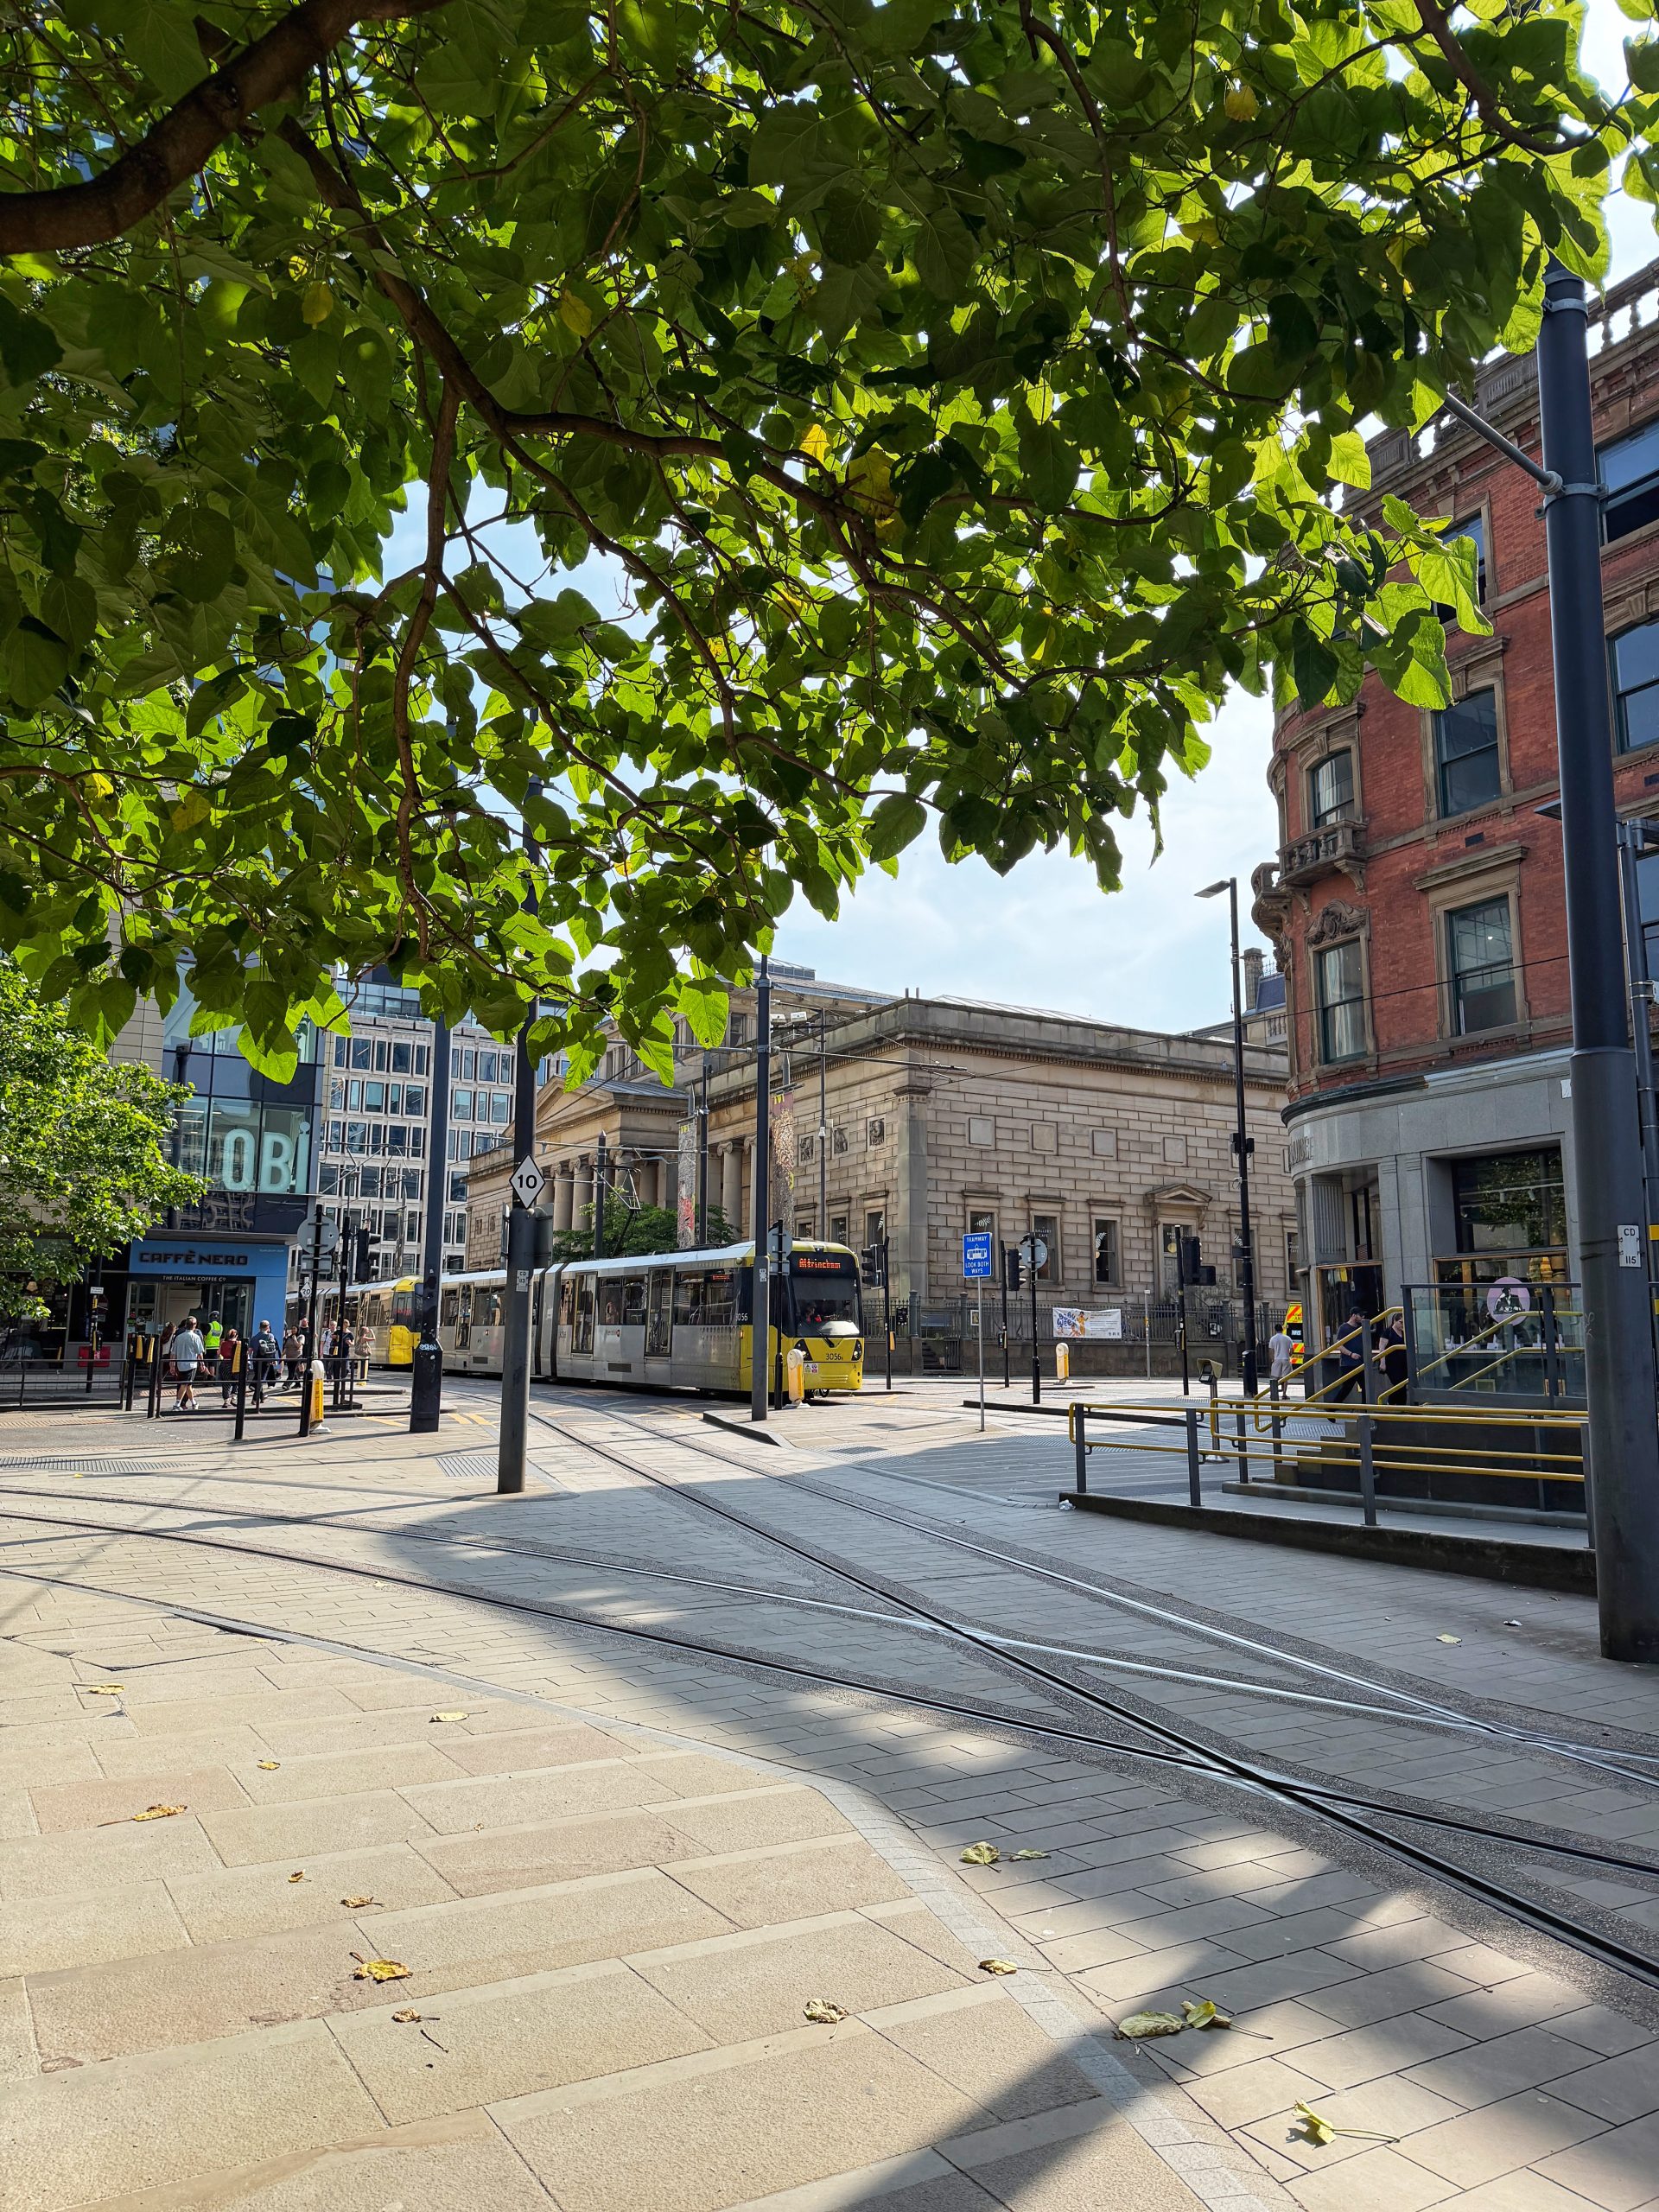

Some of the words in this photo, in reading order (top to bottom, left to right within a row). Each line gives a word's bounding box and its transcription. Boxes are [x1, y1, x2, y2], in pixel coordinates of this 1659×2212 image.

[518, 1174, 537, 1189] 10
[1624, 1228, 1636, 1236] CD
[139, 1249, 195, 1264] CAFFÈ
[197, 1254, 249, 1266] NERO
[1625, 1255, 1637, 1264] 115
